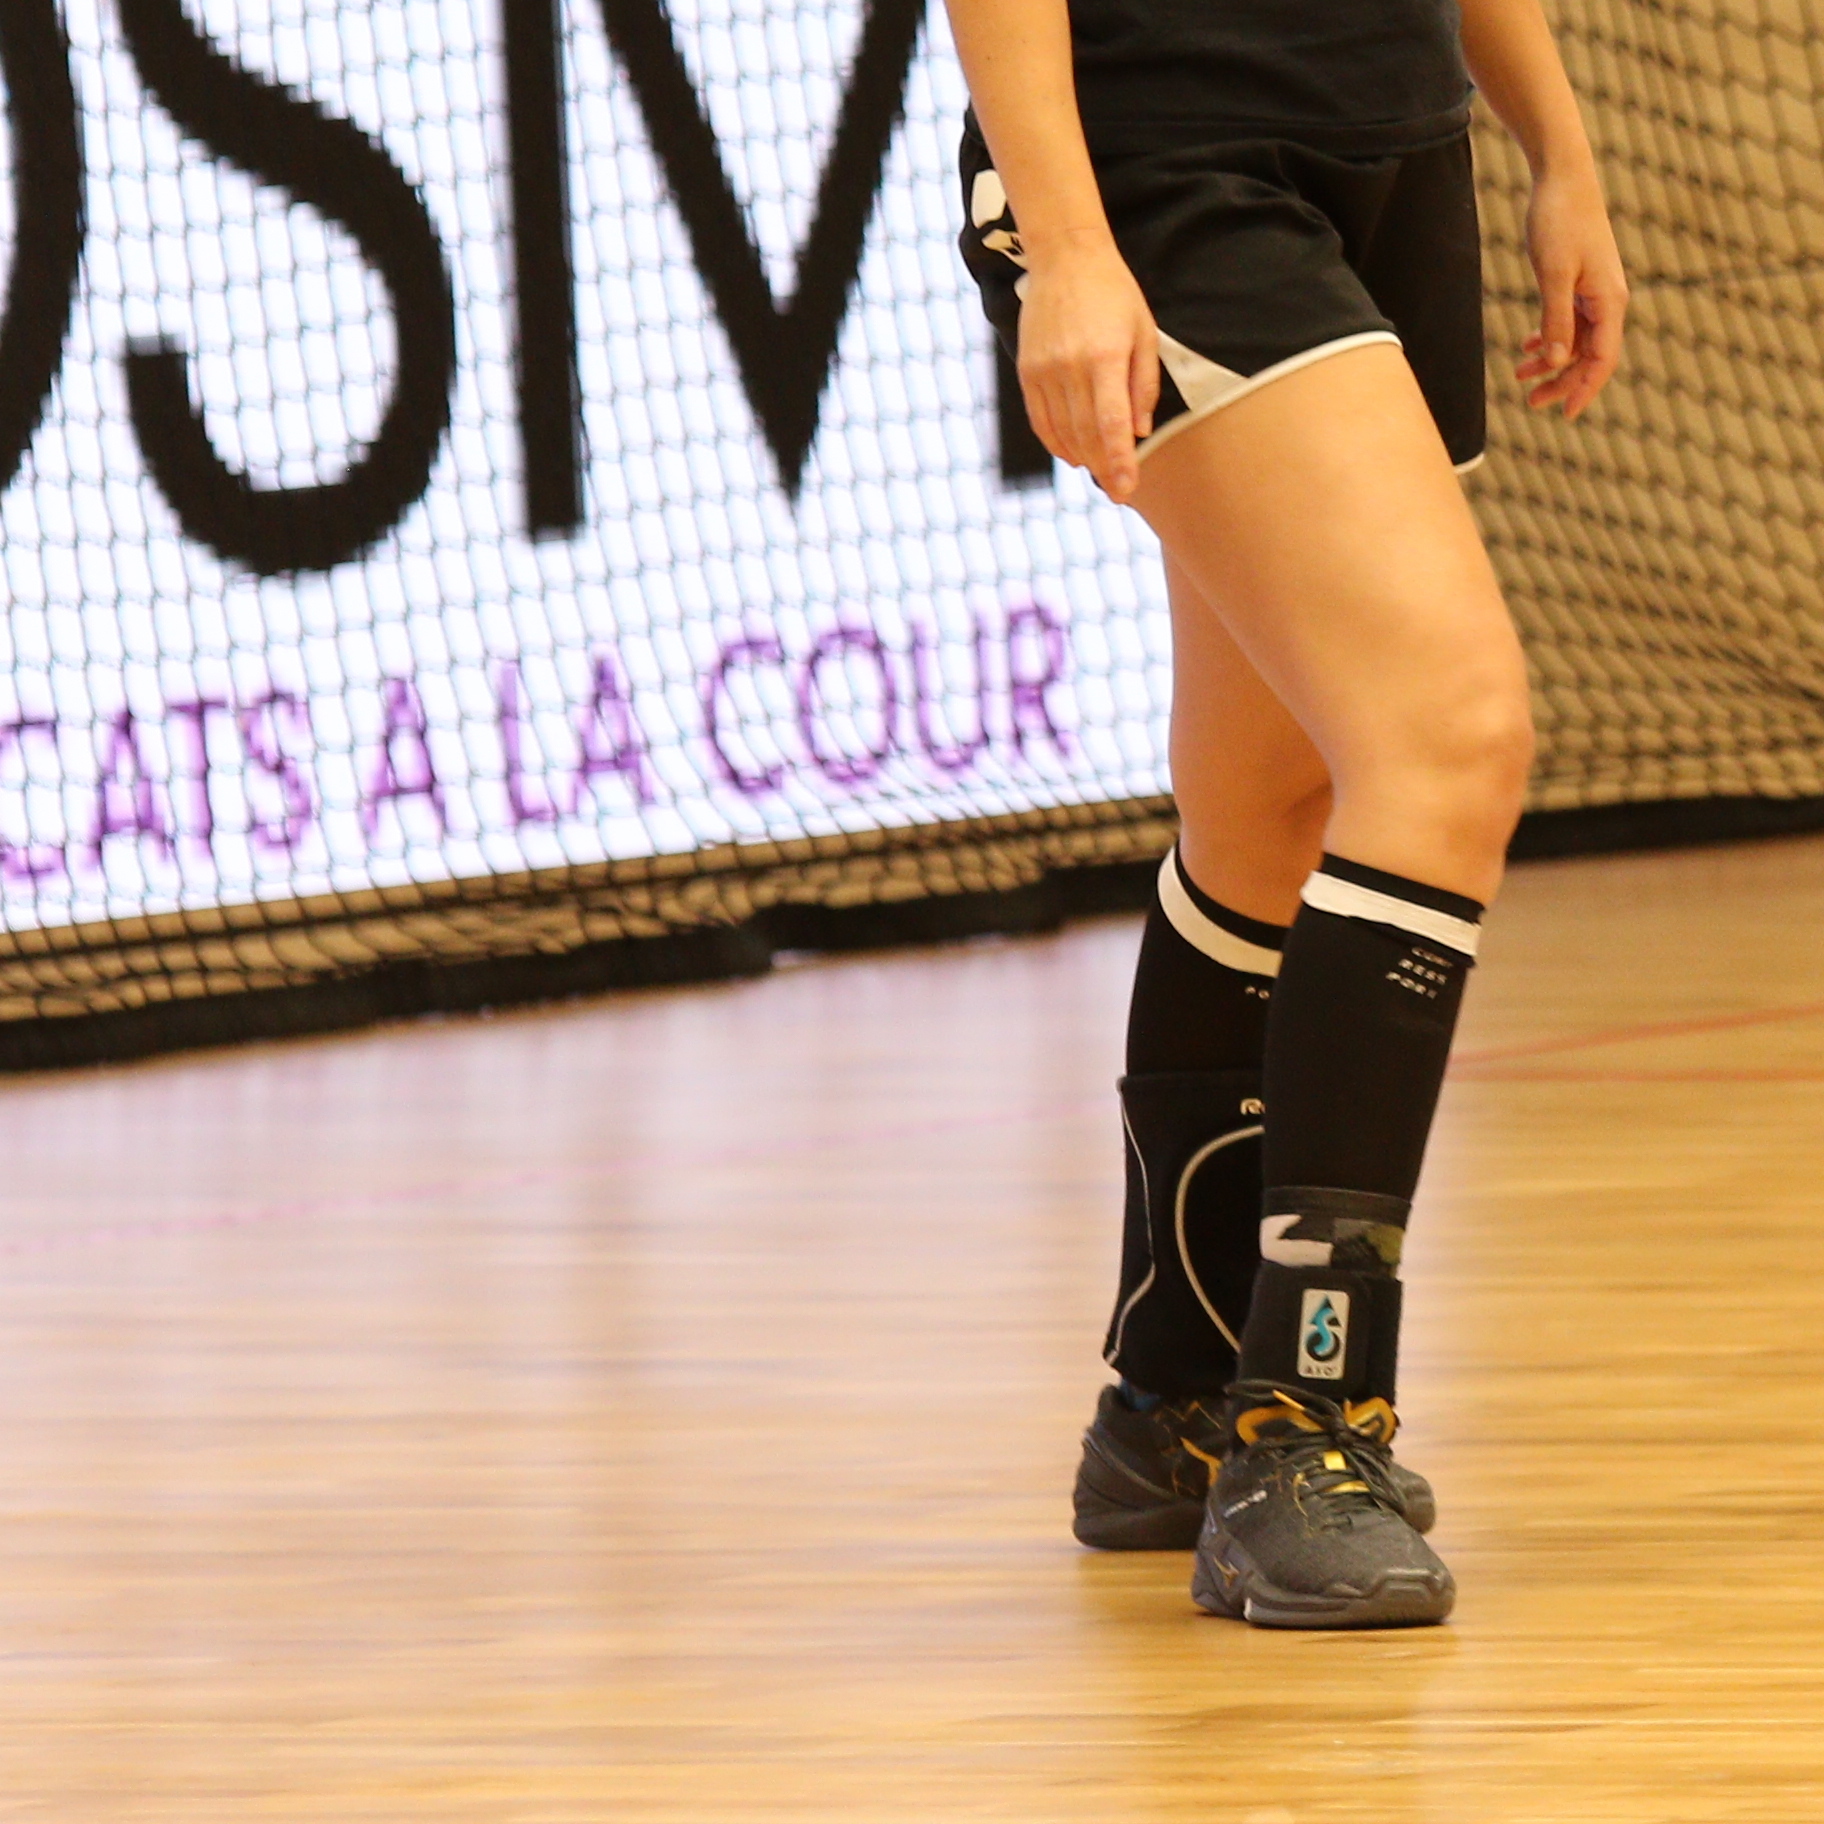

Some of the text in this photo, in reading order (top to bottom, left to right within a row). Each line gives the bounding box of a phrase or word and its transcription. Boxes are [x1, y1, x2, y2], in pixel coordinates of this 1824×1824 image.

[363, 676, 448, 838] A
[497, 654, 656, 828] LA
[700, 604, 1074, 794] COUR
